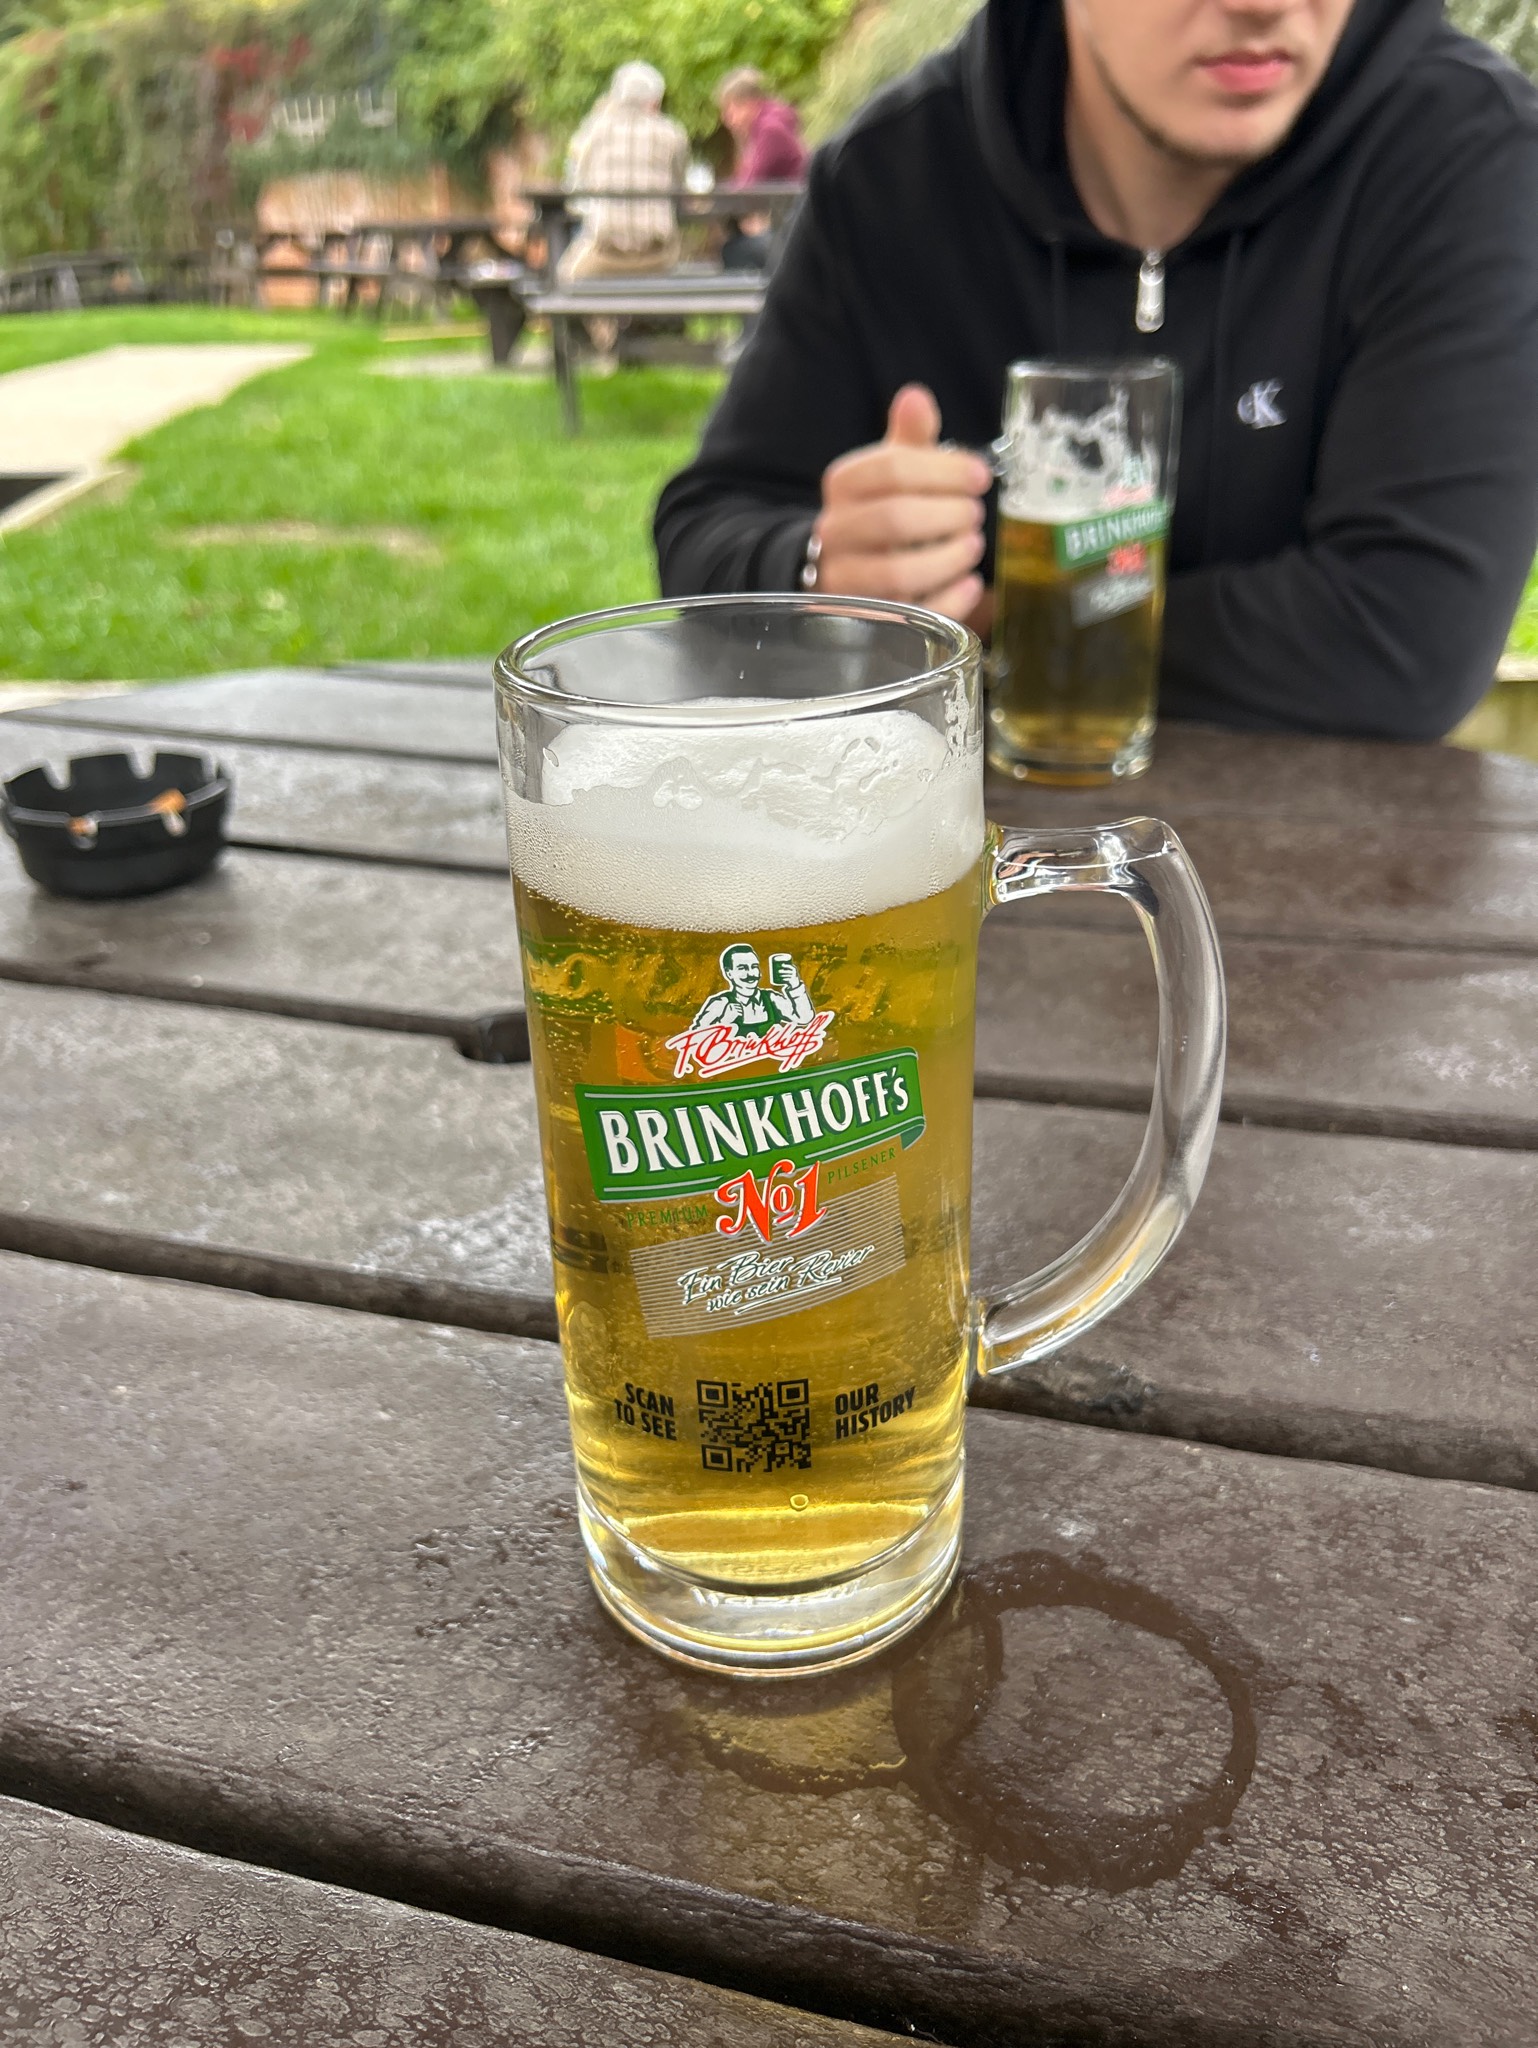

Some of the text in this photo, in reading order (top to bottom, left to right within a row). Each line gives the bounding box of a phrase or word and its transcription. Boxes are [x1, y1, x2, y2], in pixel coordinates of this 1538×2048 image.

[827, 1147, 897, 1184] PILSENER
[626, 1204, 709, 1231] PREMIUM
[677, 1245, 875, 1305] Ein Bier Revier
[706, 1275, 790, 1313] wie sein
[625, 1382, 675, 1418] SCAN
[835, 1382, 879, 1416] OUR
[836, 1385, 916, 1440] HISTORY
[614, 1398, 677, 1441] TO SEE
